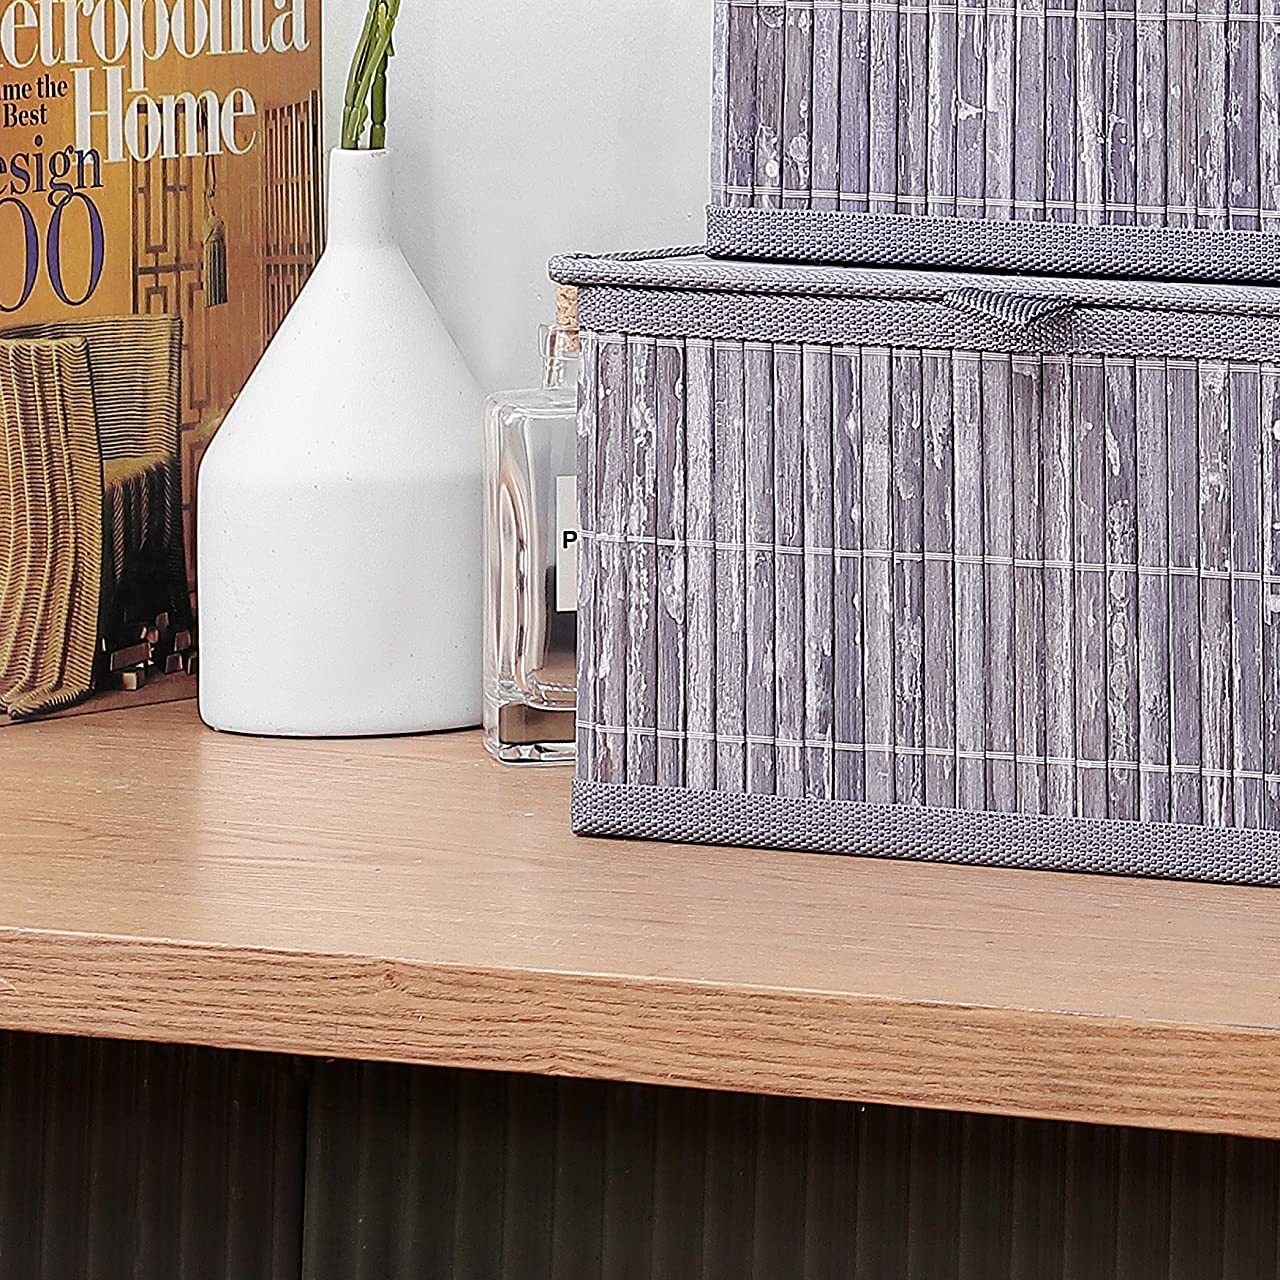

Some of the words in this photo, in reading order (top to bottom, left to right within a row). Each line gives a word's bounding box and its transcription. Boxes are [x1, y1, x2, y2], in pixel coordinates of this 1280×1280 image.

[36, 73, 68, 98] the
[3, 103, 48, 128] Best
[69, 65, 258, 166] Home
